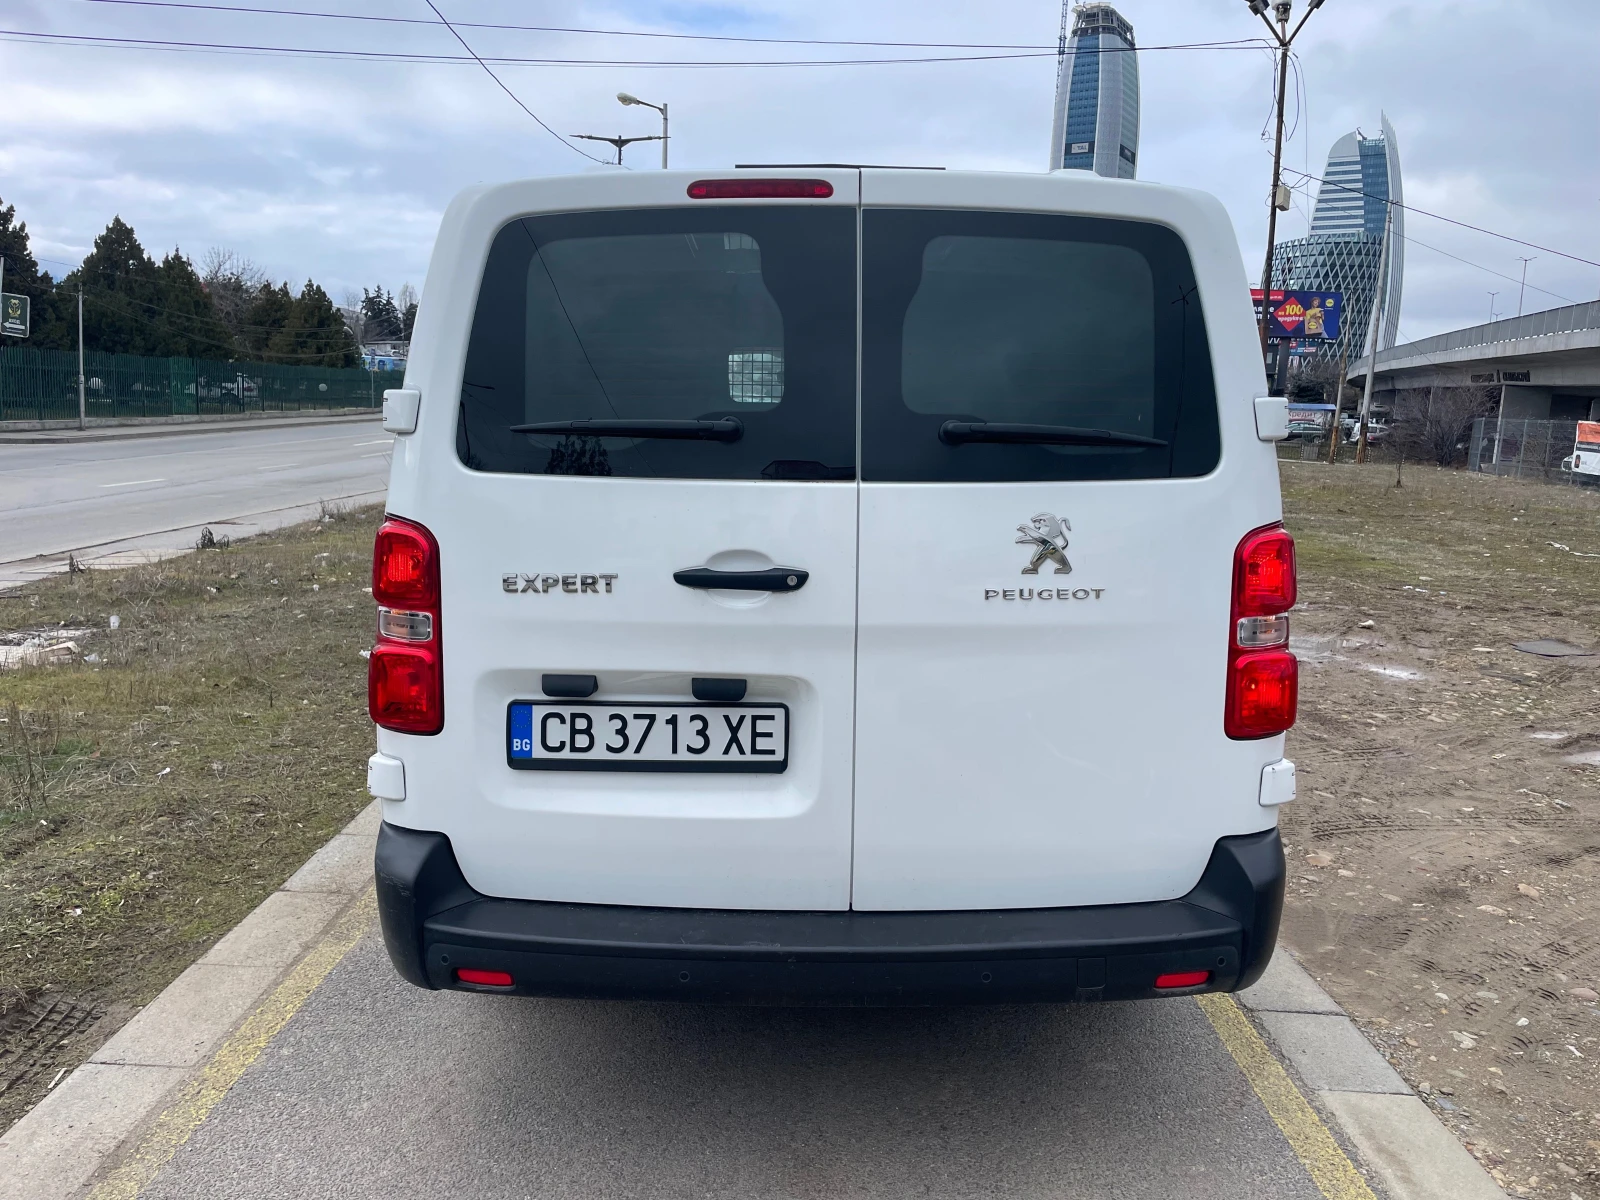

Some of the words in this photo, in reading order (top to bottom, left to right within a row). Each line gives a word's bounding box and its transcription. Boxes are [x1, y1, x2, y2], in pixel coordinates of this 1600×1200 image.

[1285, 304, 1304, 316] 100
[502, 573, 619, 594] EXPERT
[984, 587, 1106, 600] PEUGEOT
[540, 712, 595, 753] CB
[605, 713, 710, 755] 3713
[722, 714, 776, 756] XE
[513, 739, 531, 751] BG
